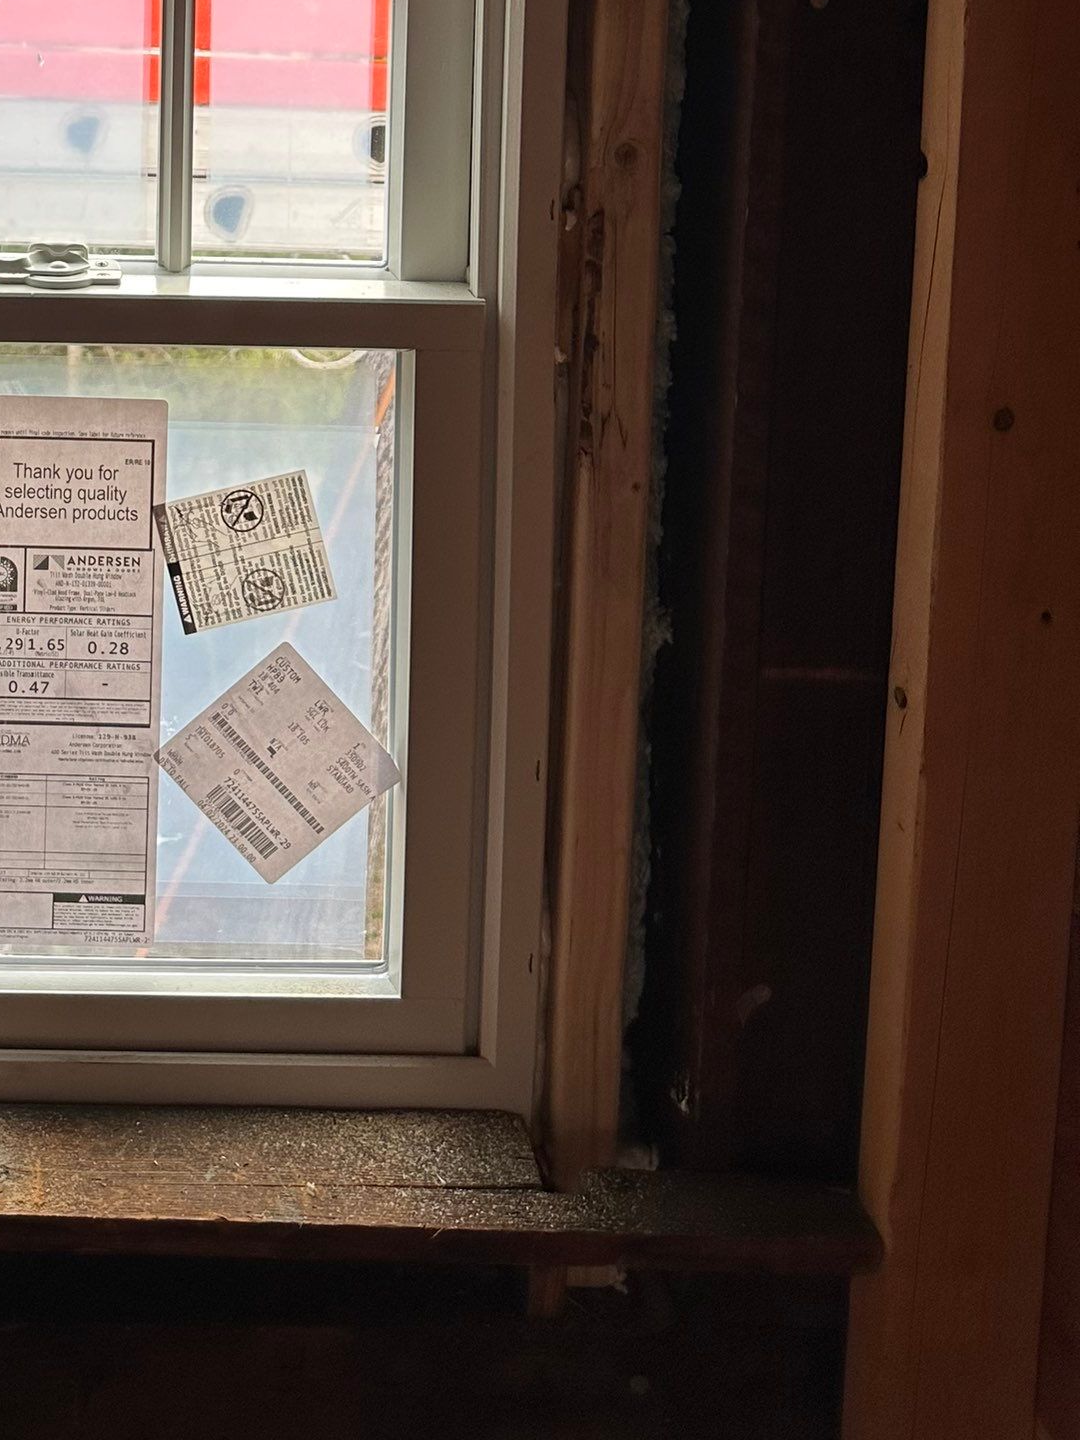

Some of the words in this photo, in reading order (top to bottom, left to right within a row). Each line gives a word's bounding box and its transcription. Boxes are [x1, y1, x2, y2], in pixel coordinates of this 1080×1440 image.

[13, 462, 60, 479] Thank
[66, 467, 92, 483] you
[98, 464, 118, 480] for
[4, 483, 72, 503] selecting
[77, 484, 127, 504] quality
[72, 504, 138, 524] products
[66, 555, 140, 566] ANDERSEN
[172, 574, 189, 615] WARNING
[39, 617, 92, 625] PERFORMANCE
[96, 618, 130, 626] RATINGS
[27, 638, 64, 651] 1.65
[87, 641, 129, 655] 0.28
[49, 661, 102, 669] PERFORMANCE
[274, 654, 302, 685] CUSTOM
[8, 680, 49, 693] 0.47
[313, 699, 329, 716] LWR
